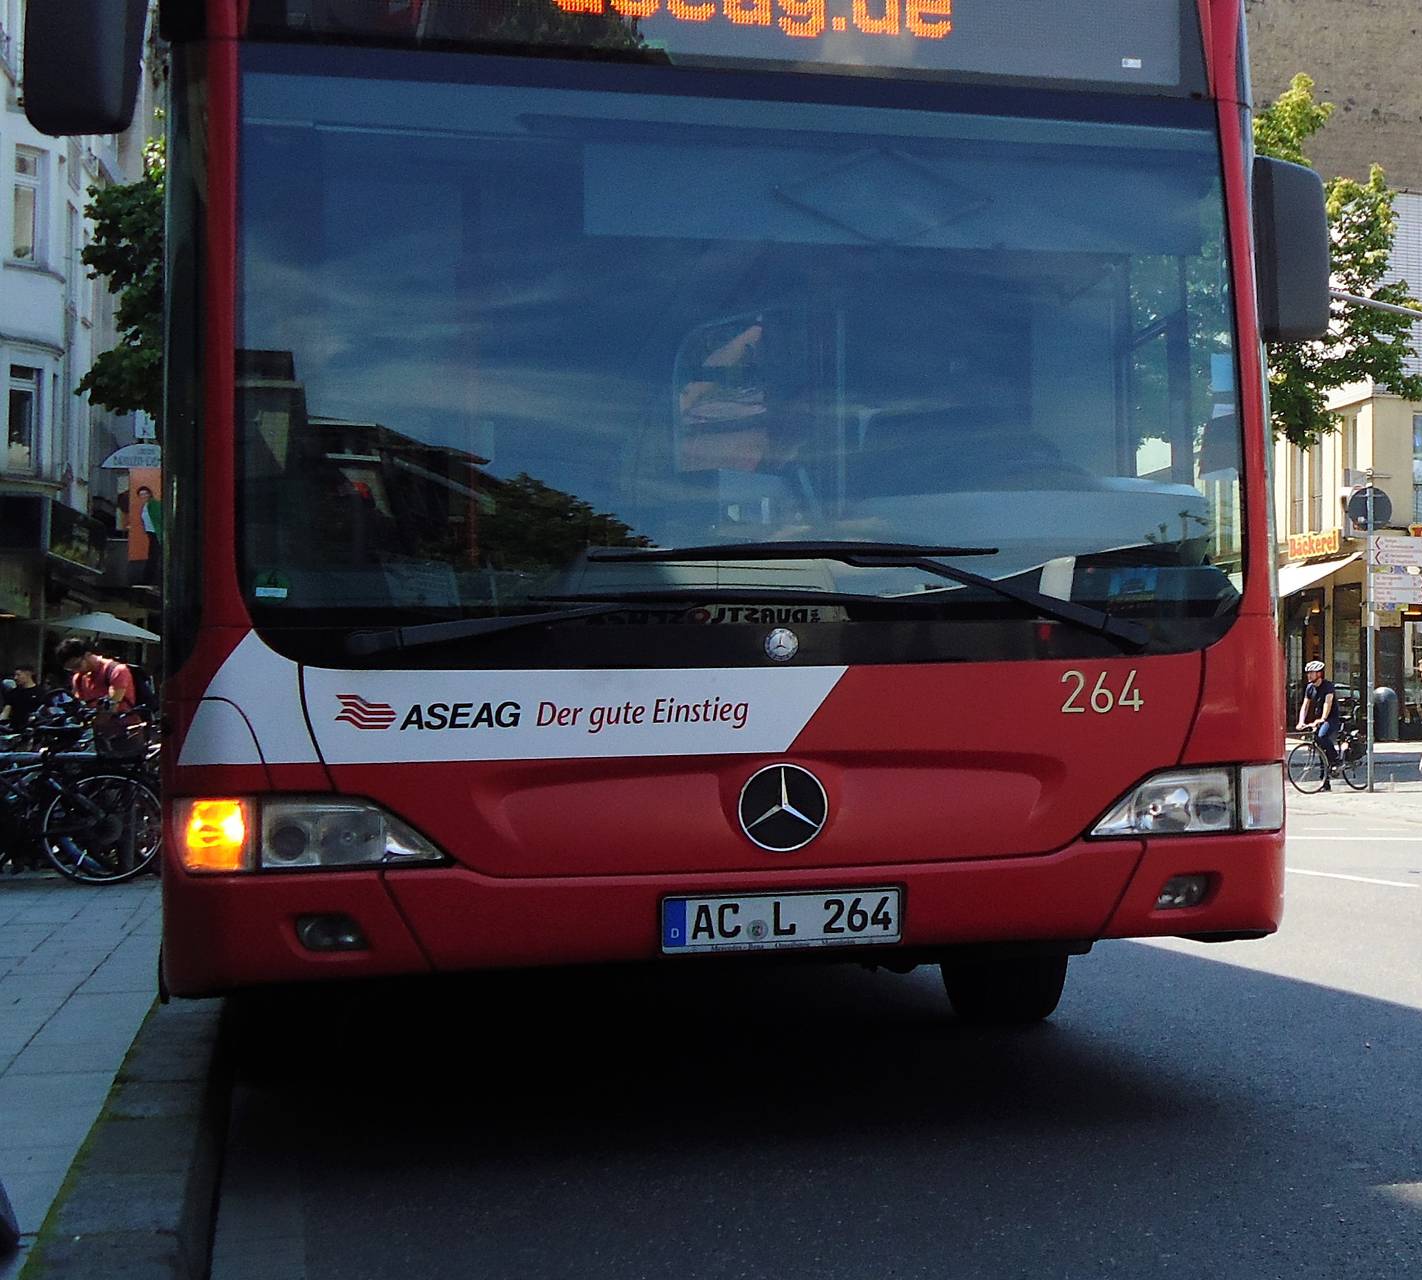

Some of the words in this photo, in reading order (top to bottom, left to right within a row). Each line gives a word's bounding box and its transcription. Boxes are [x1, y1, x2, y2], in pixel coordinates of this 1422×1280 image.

[1061, 669, 1145, 713] 264
[400, 701, 521, 730] ASEAG
[536, 701, 581, 726] Der
[588, 701, 644, 733] gute
[652, 697, 749, 729] Einstieg
[670, 927, 680, 939] D
[691, 903, 742, 940] AC
[773, 901, 797, 936] L
[822, 896, 893, 934] 264
